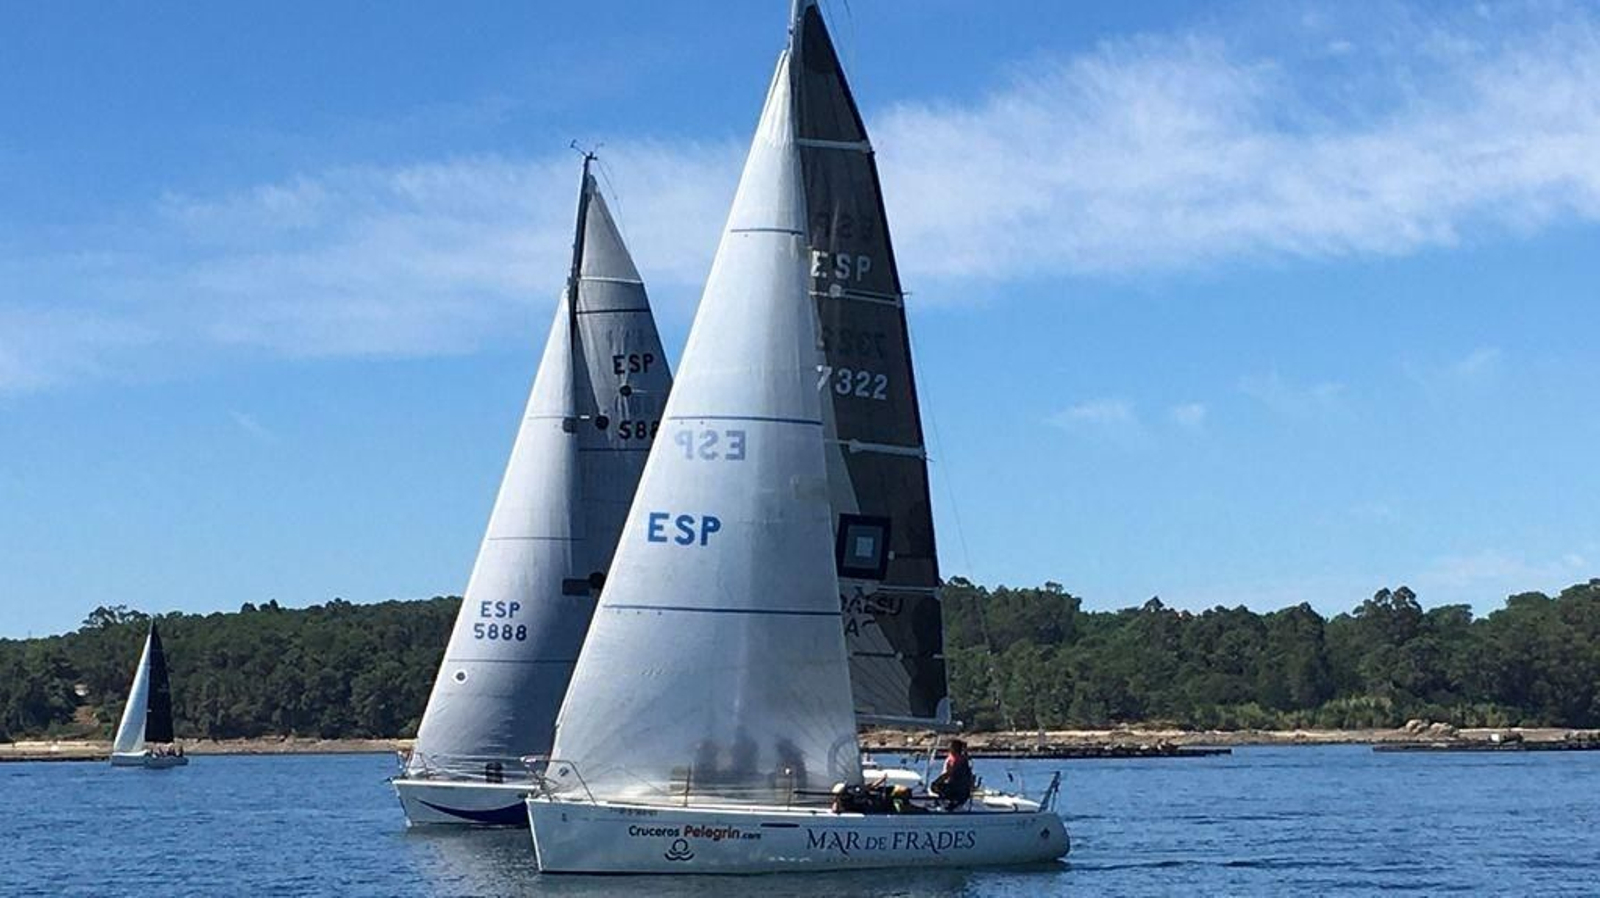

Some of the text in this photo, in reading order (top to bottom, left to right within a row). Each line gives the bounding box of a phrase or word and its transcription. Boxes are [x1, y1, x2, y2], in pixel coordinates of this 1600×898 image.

[810, 249, 871, 282] ESP
[612, 353, 654, 375] ESP
[815, 364, 888, 400] 7322
[619, 420, 661, 440] 588
[647, 512, 721, 546] ESP
[480, 601, 521, 618] ESP
[473, 623, 527, 641] 5888
[628, 825, 680, 838] Cruceros
[807, 828, 977, 855] MAR DE FRADES
